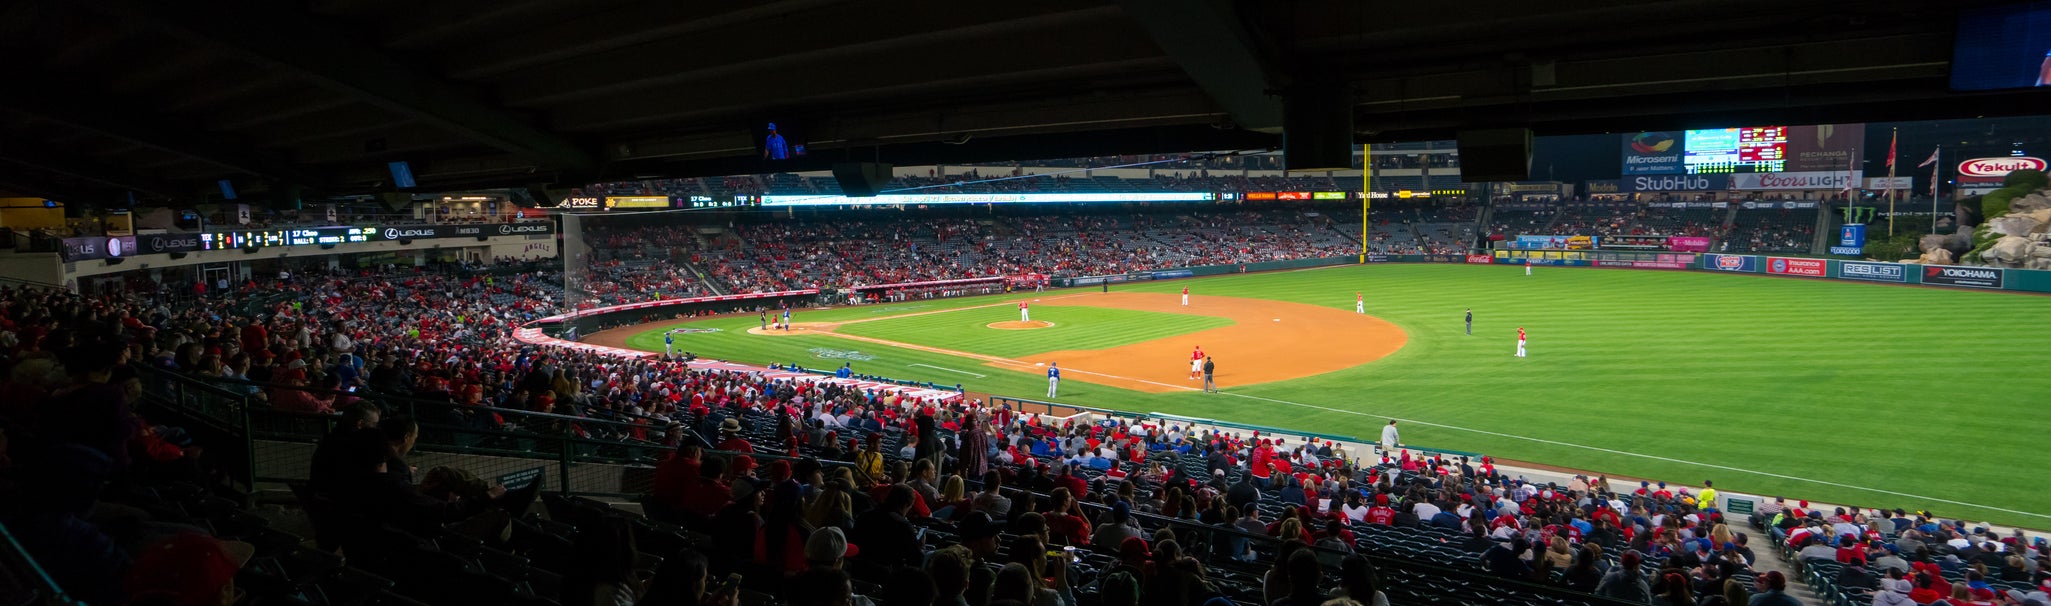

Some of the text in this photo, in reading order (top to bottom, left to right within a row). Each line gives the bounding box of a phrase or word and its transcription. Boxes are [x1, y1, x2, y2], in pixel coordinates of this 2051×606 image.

[1626, 153, 1679, 164] Microsemi
[1973, 161, 2030, 172] Yakult
[1635, 176, 1709, 191] StubHub
[1759, 172, 1851, 189] Coors LIGHT
[399, 228, 434, 237] LEXUS
[164, 240, 198, 248] LEXUS
[1942, 268, 1997, 279] YOKOHAMA
